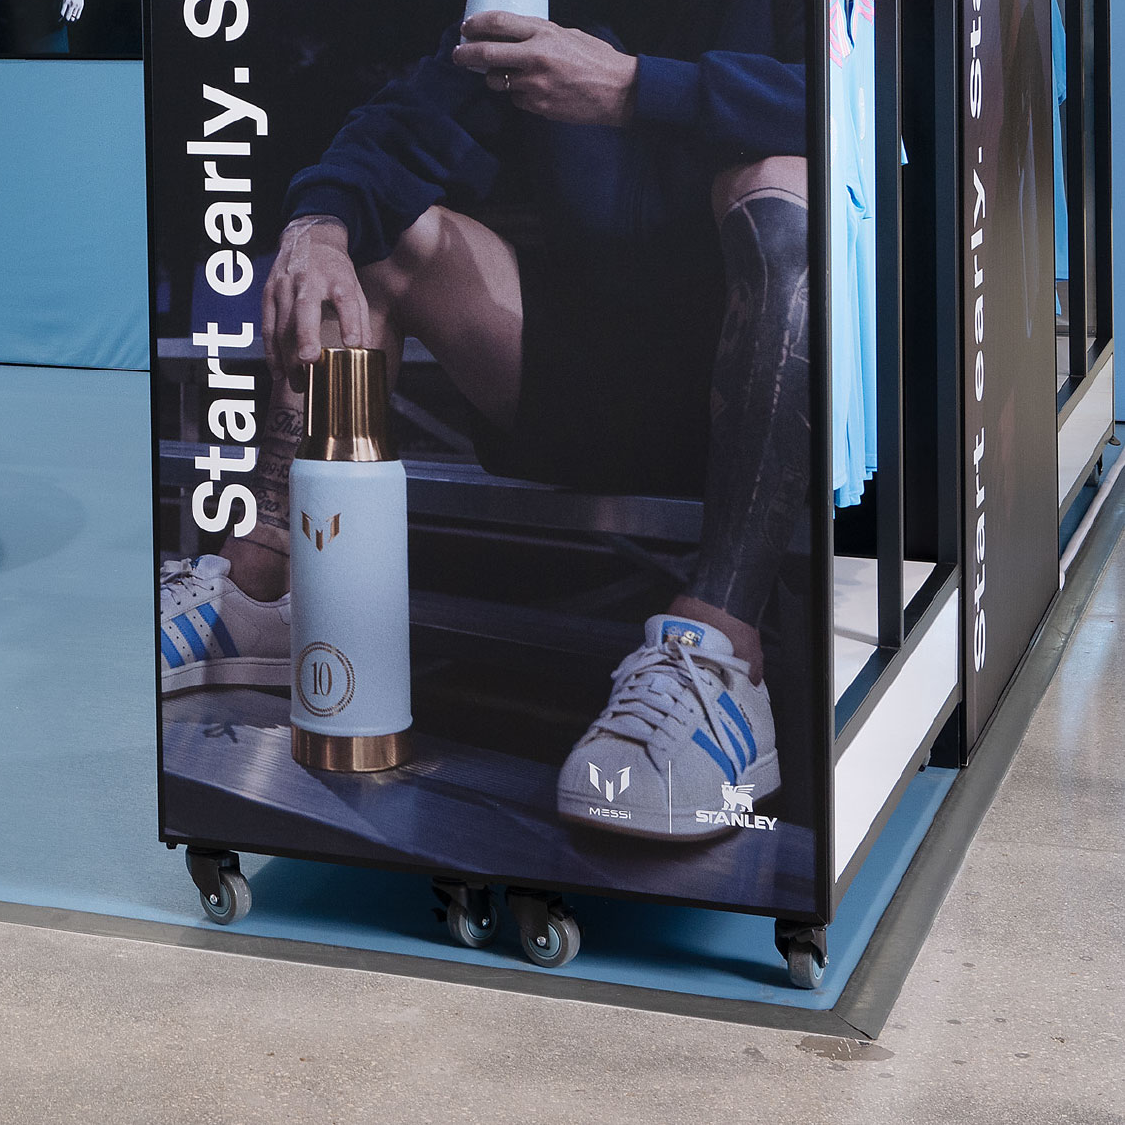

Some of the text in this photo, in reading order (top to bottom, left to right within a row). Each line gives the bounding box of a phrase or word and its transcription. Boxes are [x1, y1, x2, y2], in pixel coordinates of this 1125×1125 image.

[186, 67, 268, 296] early.
[192, 322, 258, 538] Start
[973, 428, 986, 672] Start
[311, 661, 333, 696] 10
[696, 810, 778, 831] STANLEY
